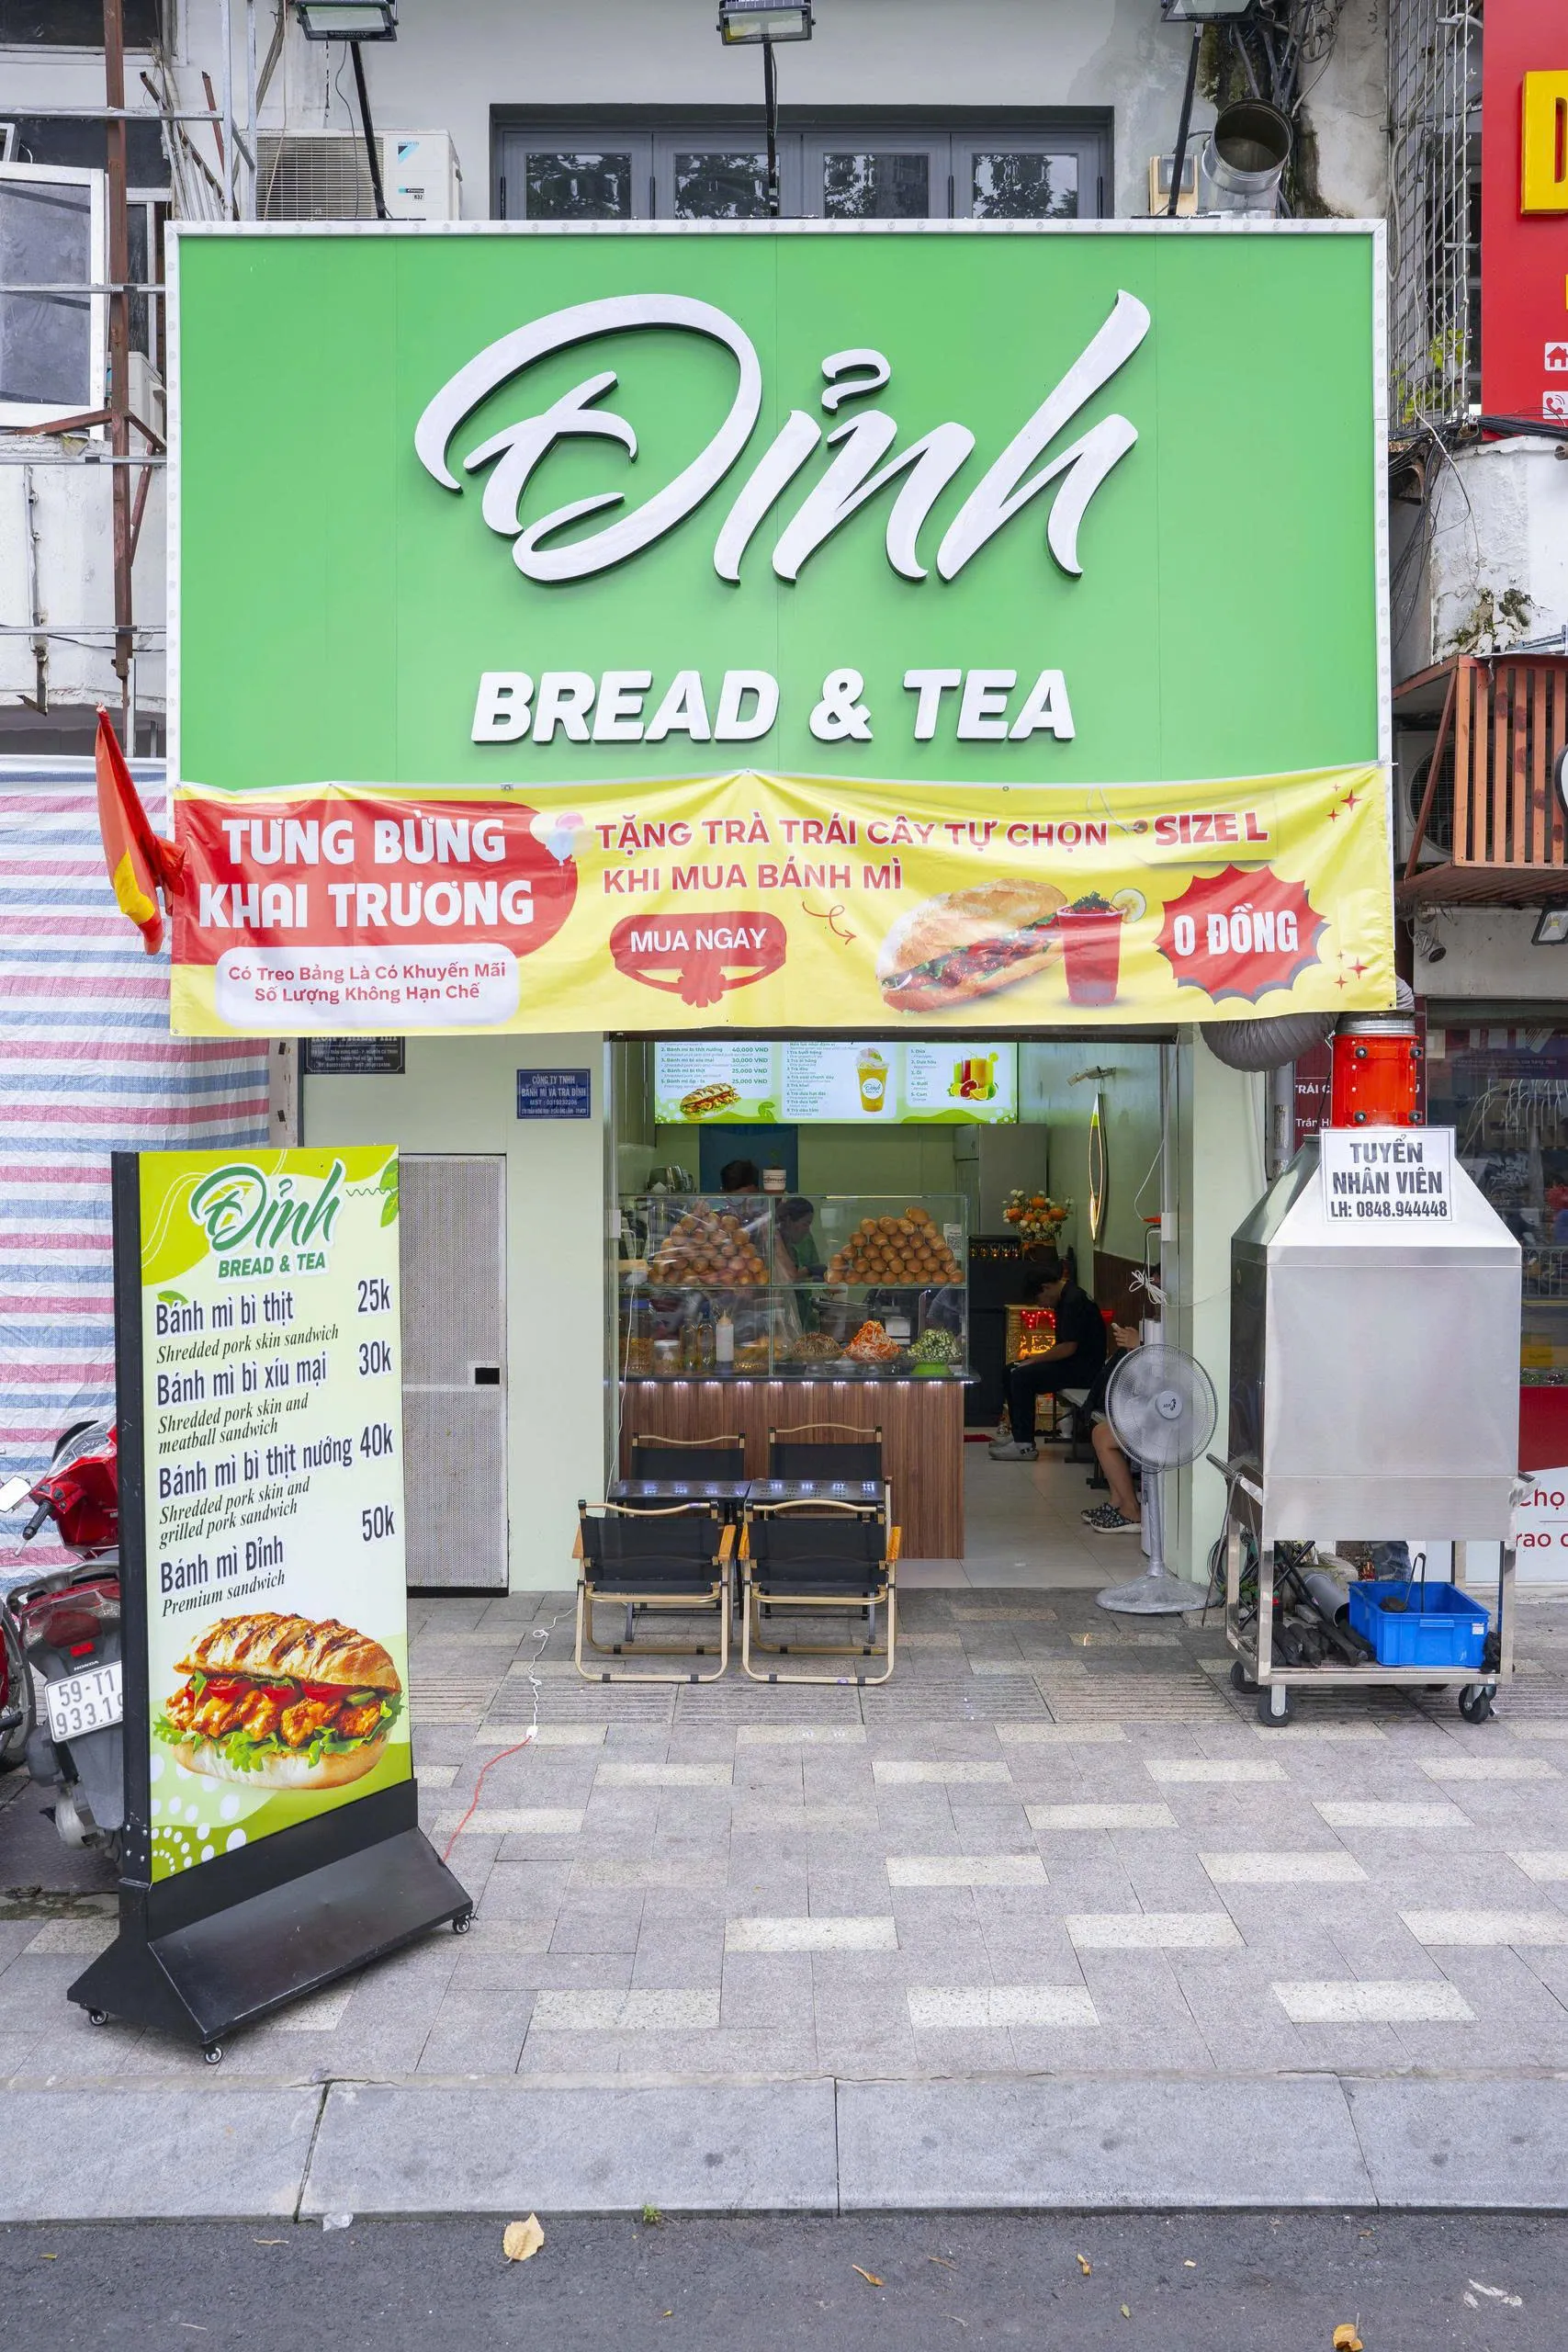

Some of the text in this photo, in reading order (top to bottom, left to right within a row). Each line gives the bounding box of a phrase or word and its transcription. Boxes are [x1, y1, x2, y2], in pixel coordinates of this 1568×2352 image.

[471, 667, 1076, 743] BREAD & TEA
[595, 811, 1107, 856] TẶNG TRÀ TRÁI CÂY TỰ CHỌN
[1154, 812, 1269, 846] SIZE L
[604, 856, 902, 894] KHI MUA BÁNH MÌ
[198, 883, 308, 928] KHAI
[630, 927, 768, 953] MUA NGAY
[1206, 902, 1299, 956] ĐỒNG
[229, 961, 506, 984] Có Treo Bảng Là Có Khuyến Mãi
[254, 981, 480, 1005] Số Lượng Không Hạn Chế
[549, 1075, 558, 1084] TY
[1295, 1082, 1319, 1094] RÁI
[1349, 1133, 1423, 1164] TUYỂN
[1333, 1166, 1443, 1194] NHÂN VIÊN
[1331, 1200, 1448, 1218] LH: 0848.944448
[218, 1251, 326, 1278] BREAD & TEA
[156, 1278, 390, 1336] Bánh mì bì thịt 25k
[156, 1324, 339, 1364] Shredded pork skin sandwich
[157, 1340, 391, 1406] Bánh mì bì xíu mại 30k
[157, 1392, 309, 1434] Shredded pork skin and
[158, 1418, 278, 1454] meatball sandwich
[159, 1422, 393, 1499] Bánh mì bì thịt nướng 40k
[159, 1476, 310, 1525] Shredded pork skin and
[1520, 1488, 1565, 1510] họ
[159, 1498, 298, 1550] grilled pork sandwich
[362, 1505, 395, 1542] 50k
[161, 1535, 284, 1594] Bánh mì Đỉnh
[163, 1569, 286, 1618] Premium sandwich
[73, 1660, 99, 1671] HONDA
[58, 1668, 115, 1707] 59-T1
